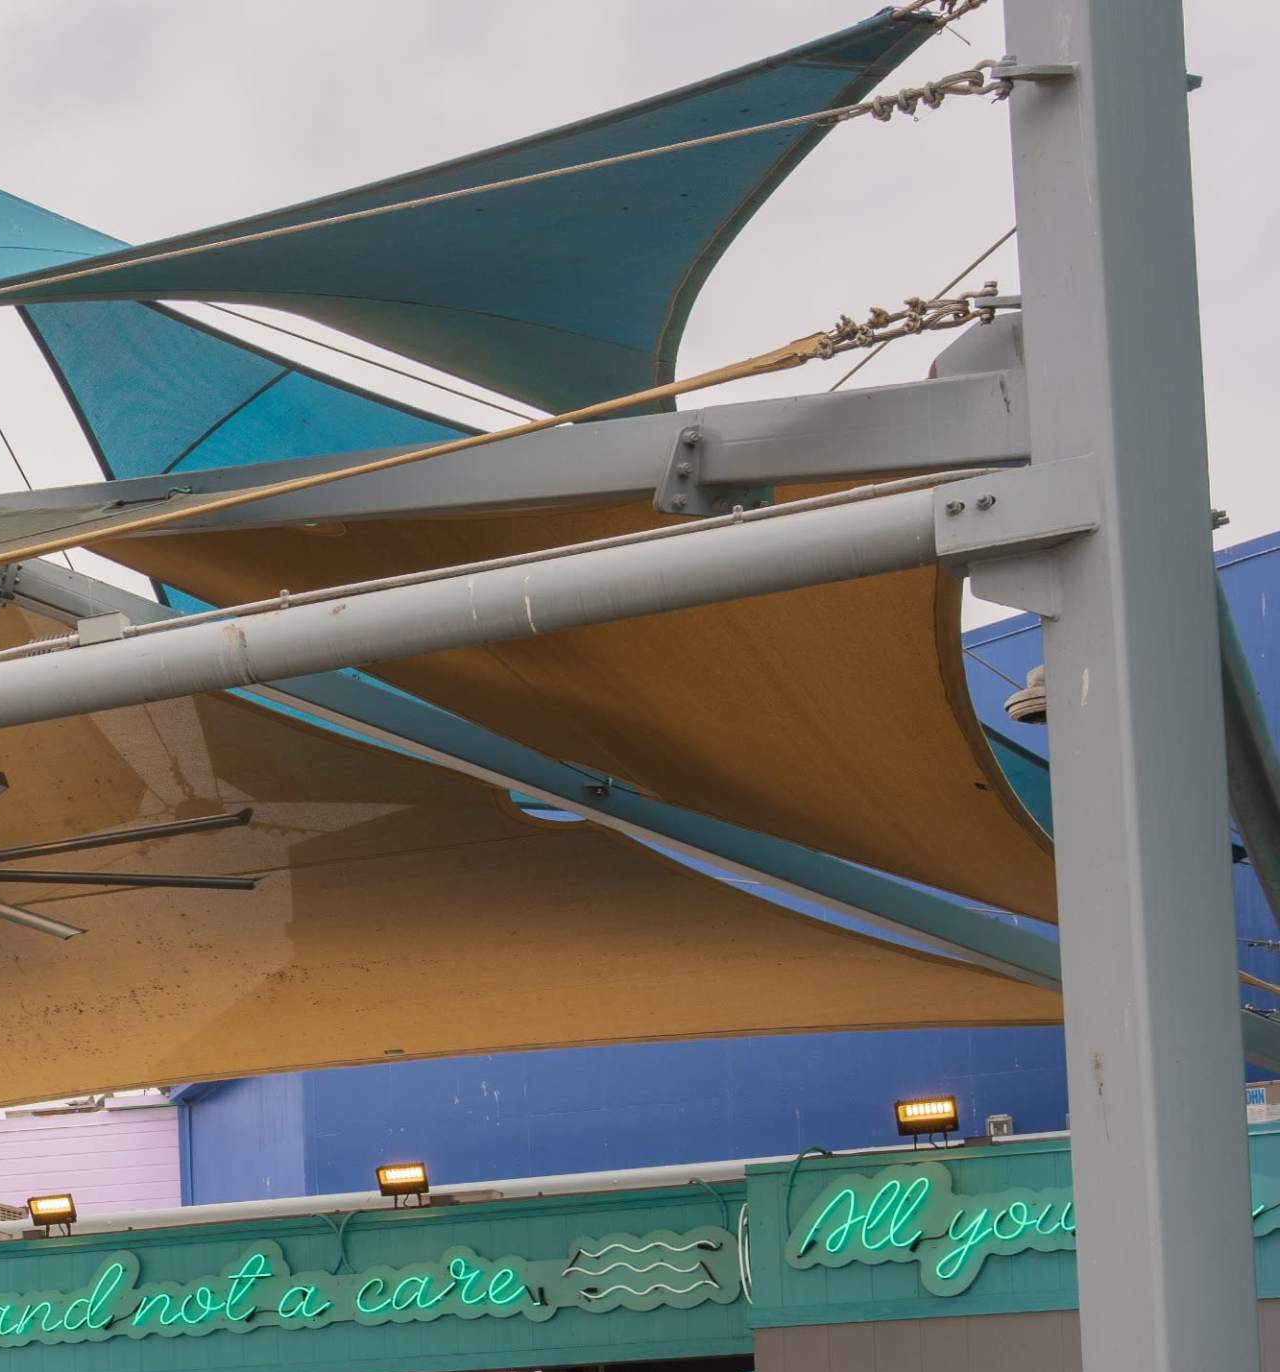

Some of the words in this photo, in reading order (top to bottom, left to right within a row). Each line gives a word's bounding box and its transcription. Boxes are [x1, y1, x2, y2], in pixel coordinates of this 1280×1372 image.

[799, 1177, 929, 1258] All
[132, 1252, 272, 1325] not
[278, 1286, 331, 1318] a
